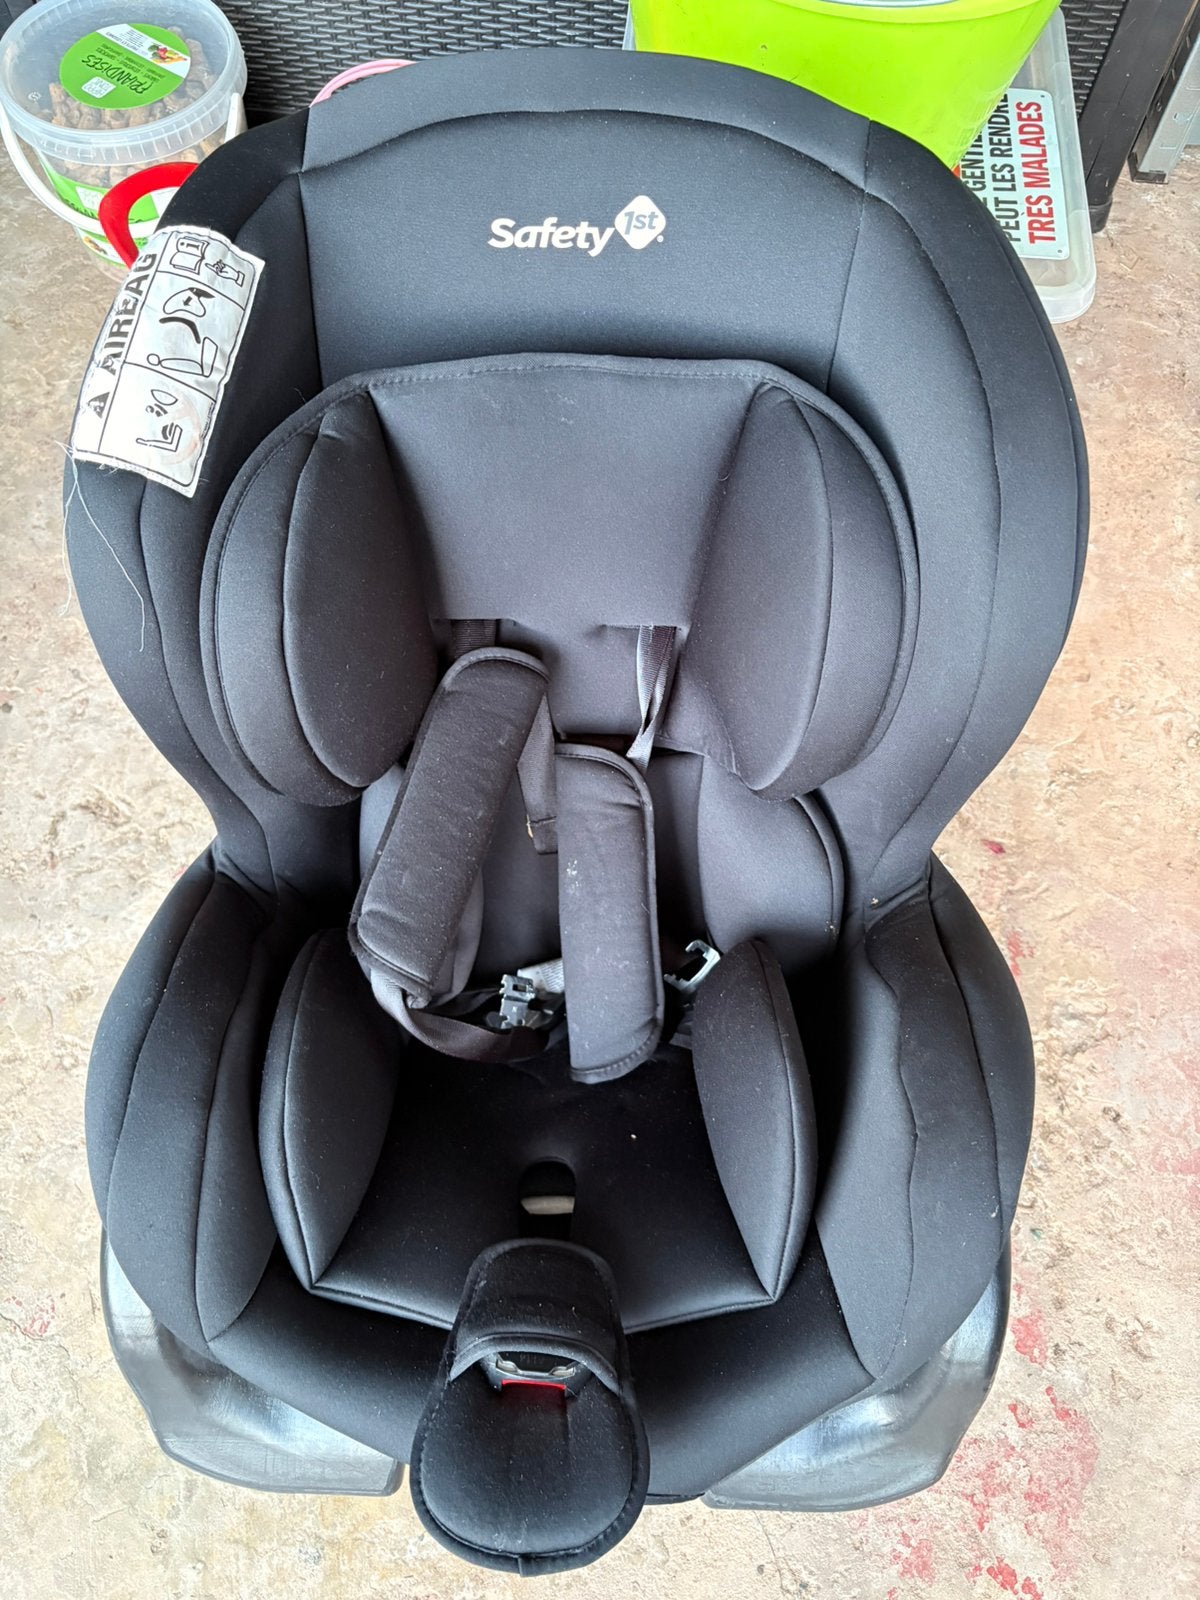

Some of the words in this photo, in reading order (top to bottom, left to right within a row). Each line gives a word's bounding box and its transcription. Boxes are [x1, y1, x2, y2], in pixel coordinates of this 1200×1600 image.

[1015, 101, 1051, 189] MALADES
[990, 163, 1016, 192] LES
[487, 217, 616, 257] Safety
[624, 211, 659, 235] 1st
[994, 196, 1021, 242] PEUT
[101, 253, 158, 376] AIRBAG
